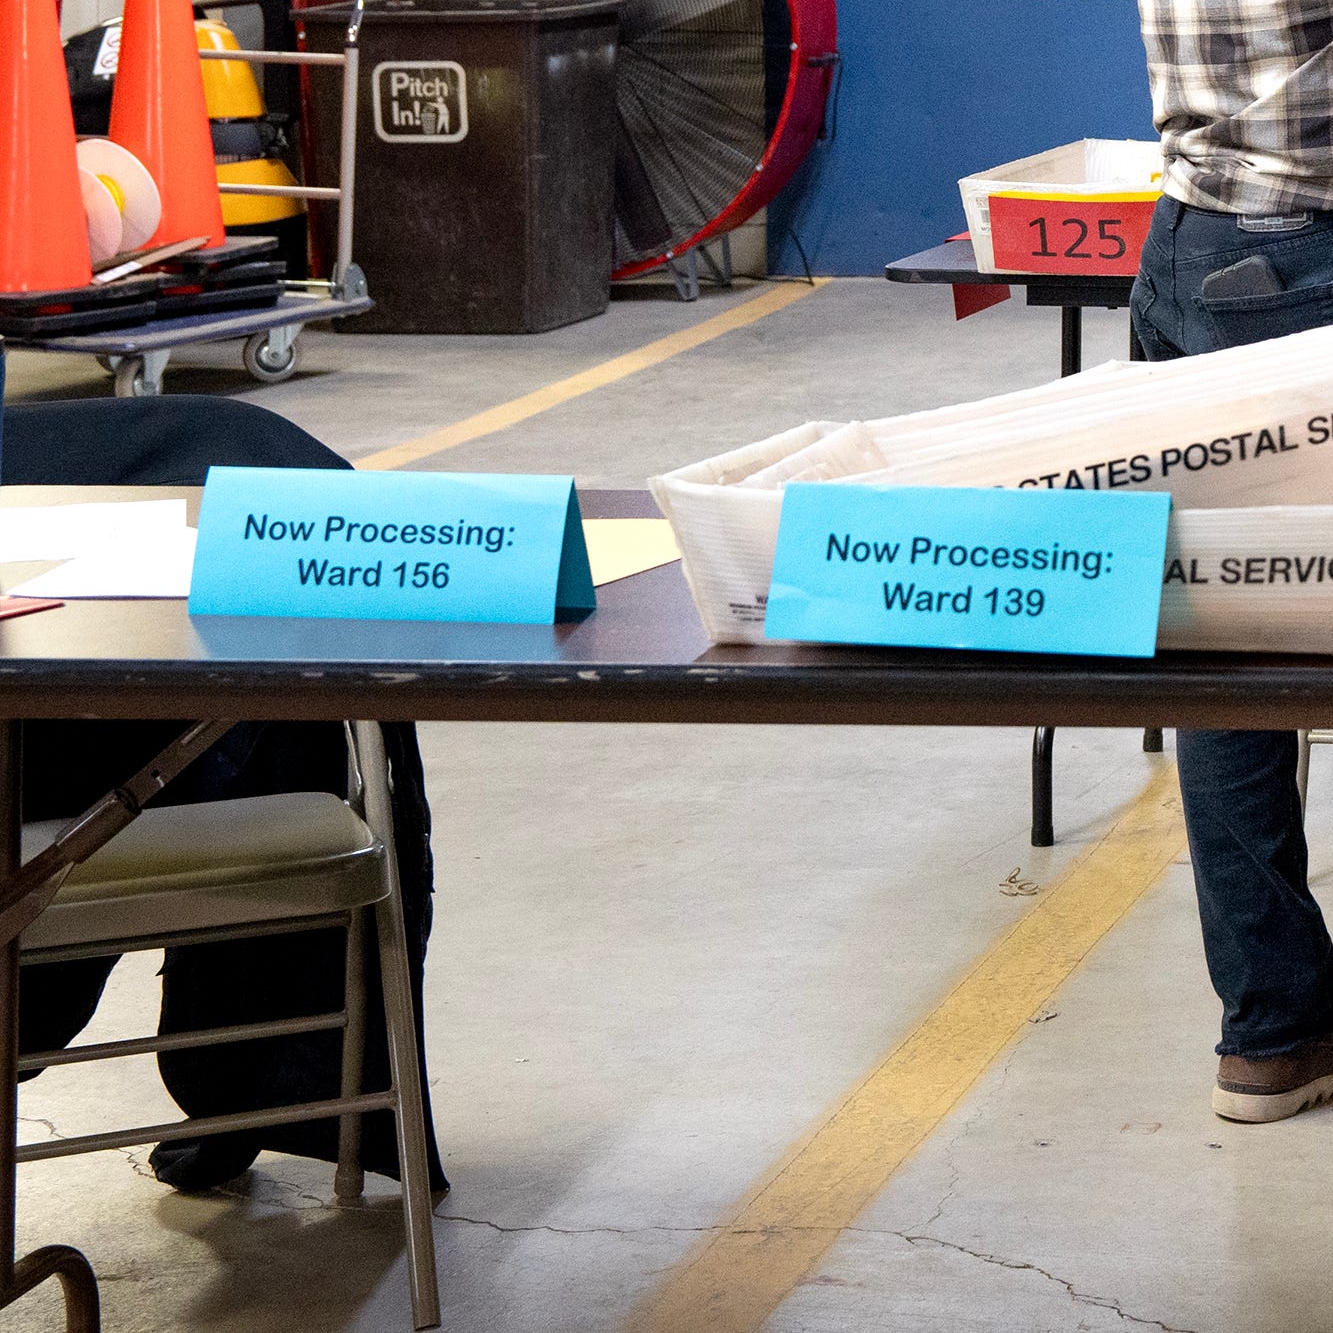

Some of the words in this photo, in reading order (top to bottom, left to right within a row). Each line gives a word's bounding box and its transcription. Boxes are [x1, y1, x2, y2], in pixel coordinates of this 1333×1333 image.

[391, 72, 449, 97] Pitch
[392, 100, 422, 126] In!
[1029, 217, 1126, 260] 125
[1159, 425, 1298, 478] POSTAL
[244, 513, 315, 542] Now
[324, 516, 516, 553] Processing:
[297, 558, 382, 588] Ward
[394, 562, 450, 589] 156
[826, 533, 899, 564] Now
[911, 536, 1114, 580] Processing:
[882, 582, 971, 615] Ward
[982, 586, 1046, 617] 139
